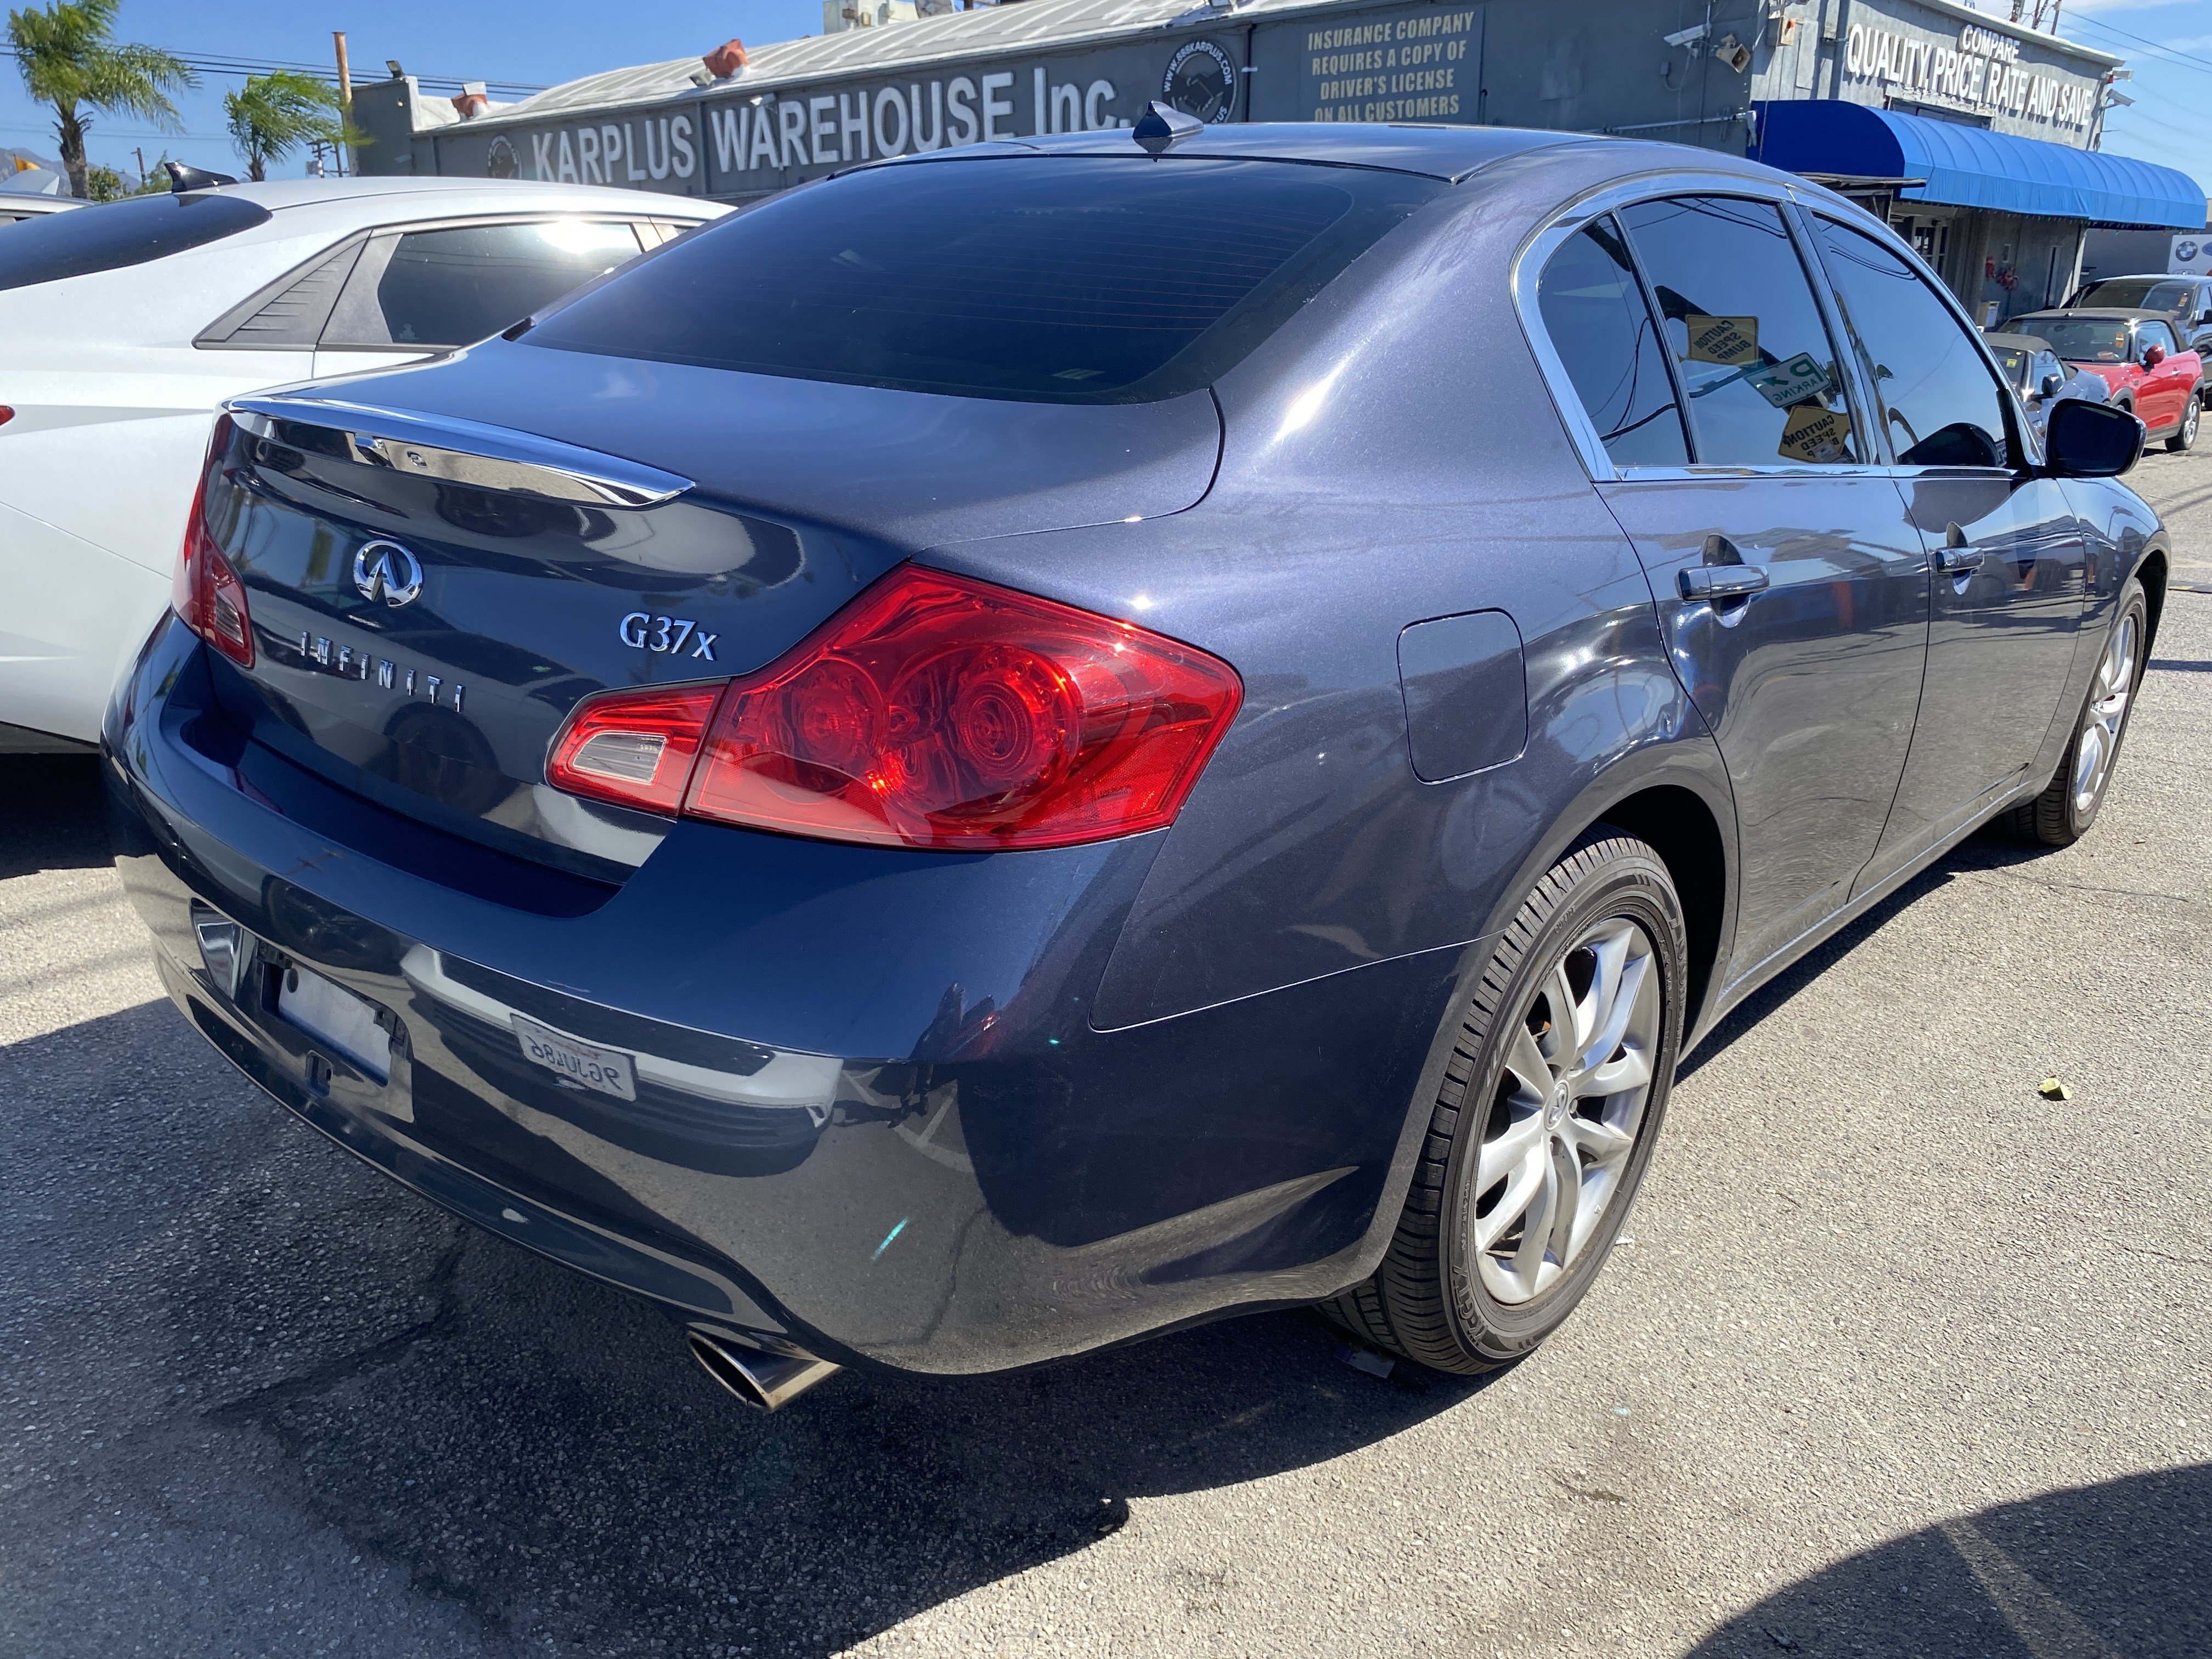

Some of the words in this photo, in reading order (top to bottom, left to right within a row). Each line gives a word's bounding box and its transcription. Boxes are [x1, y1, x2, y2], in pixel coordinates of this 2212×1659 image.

[1308, 22, 1392, 51] INSURANCE
[1396, 12, 1474, 40] COMPANY
[1960, 24, 2020, 64] COMPARE
[1312, 50, 1383, 76] REQUIRES
[1386, 49, 1396, 67] A
[1401, 43, 1443, 66] COPY
[1447, 40, 1467, 61] OF
[1321, 75, 1387, 100] DRIVER'S
[1391, 69, 1454, 93] LICENSE
[1932, 47, 1985, 103] PRICE,
[1987, 62, 2028, 110] RATE
[2027, 75, 2058, 117] AND
[2057, 83, 2093, 126] SAVE
[532, 116, 696, 184] KARPLUS
[711, 71, 1015, 172] WAREHOUSE
[1034, 67, 1131, 135] Inc.
[1314, 107, 1333, 122] ON
[1338, 104, 1361, 122] ALL
[1365, 94, 1459, 122] CUSTOMERS
[301, 631, 466, 713] INFINITI
